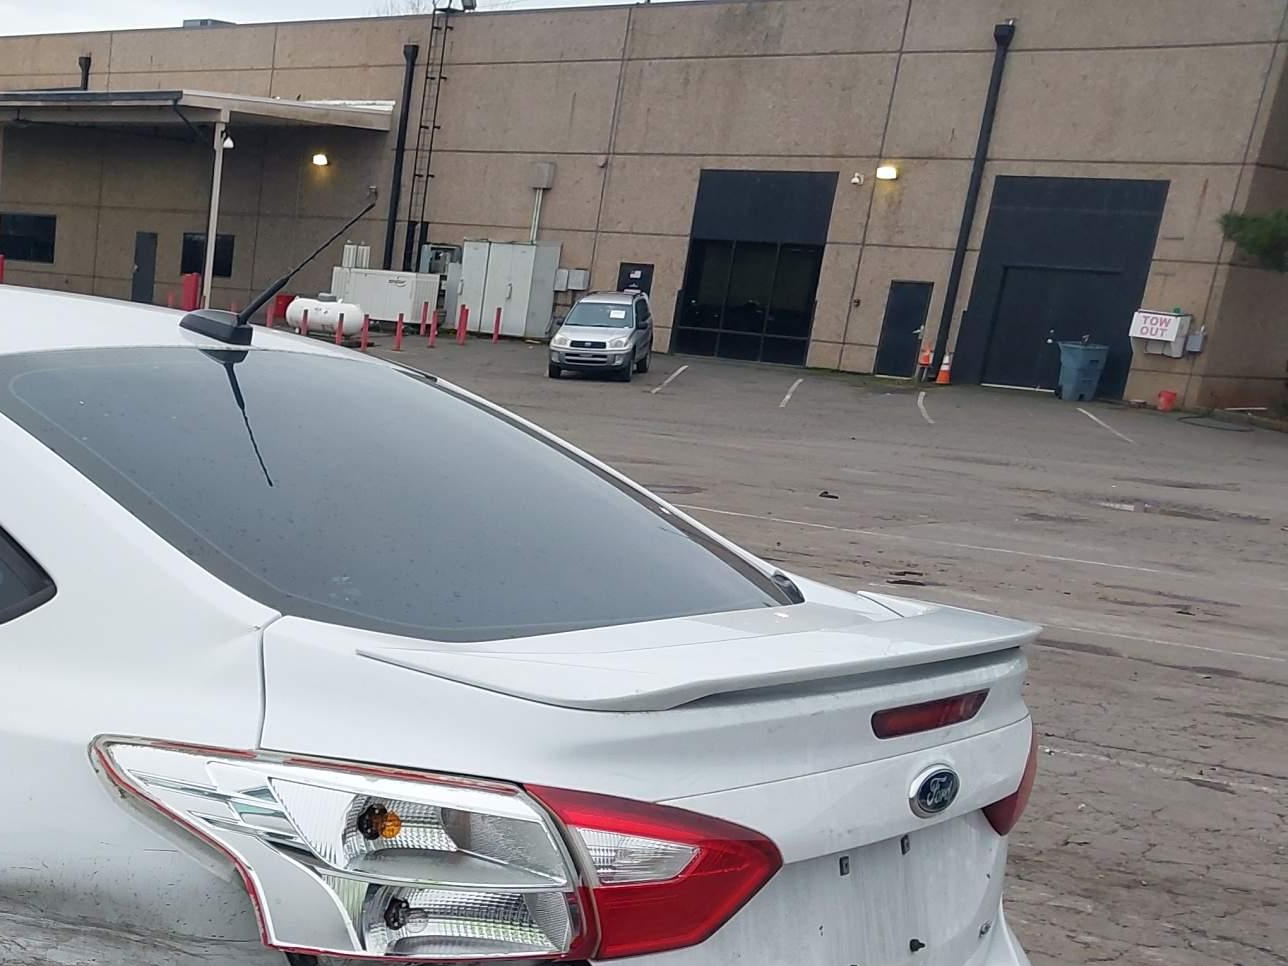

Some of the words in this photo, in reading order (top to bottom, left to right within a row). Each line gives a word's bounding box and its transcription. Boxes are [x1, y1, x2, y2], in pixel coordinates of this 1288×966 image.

[1142, 315, 1171, 327] TOW
[1140, 326, 1168, 337] OUT
[926, 776, 953, 806] Ford
